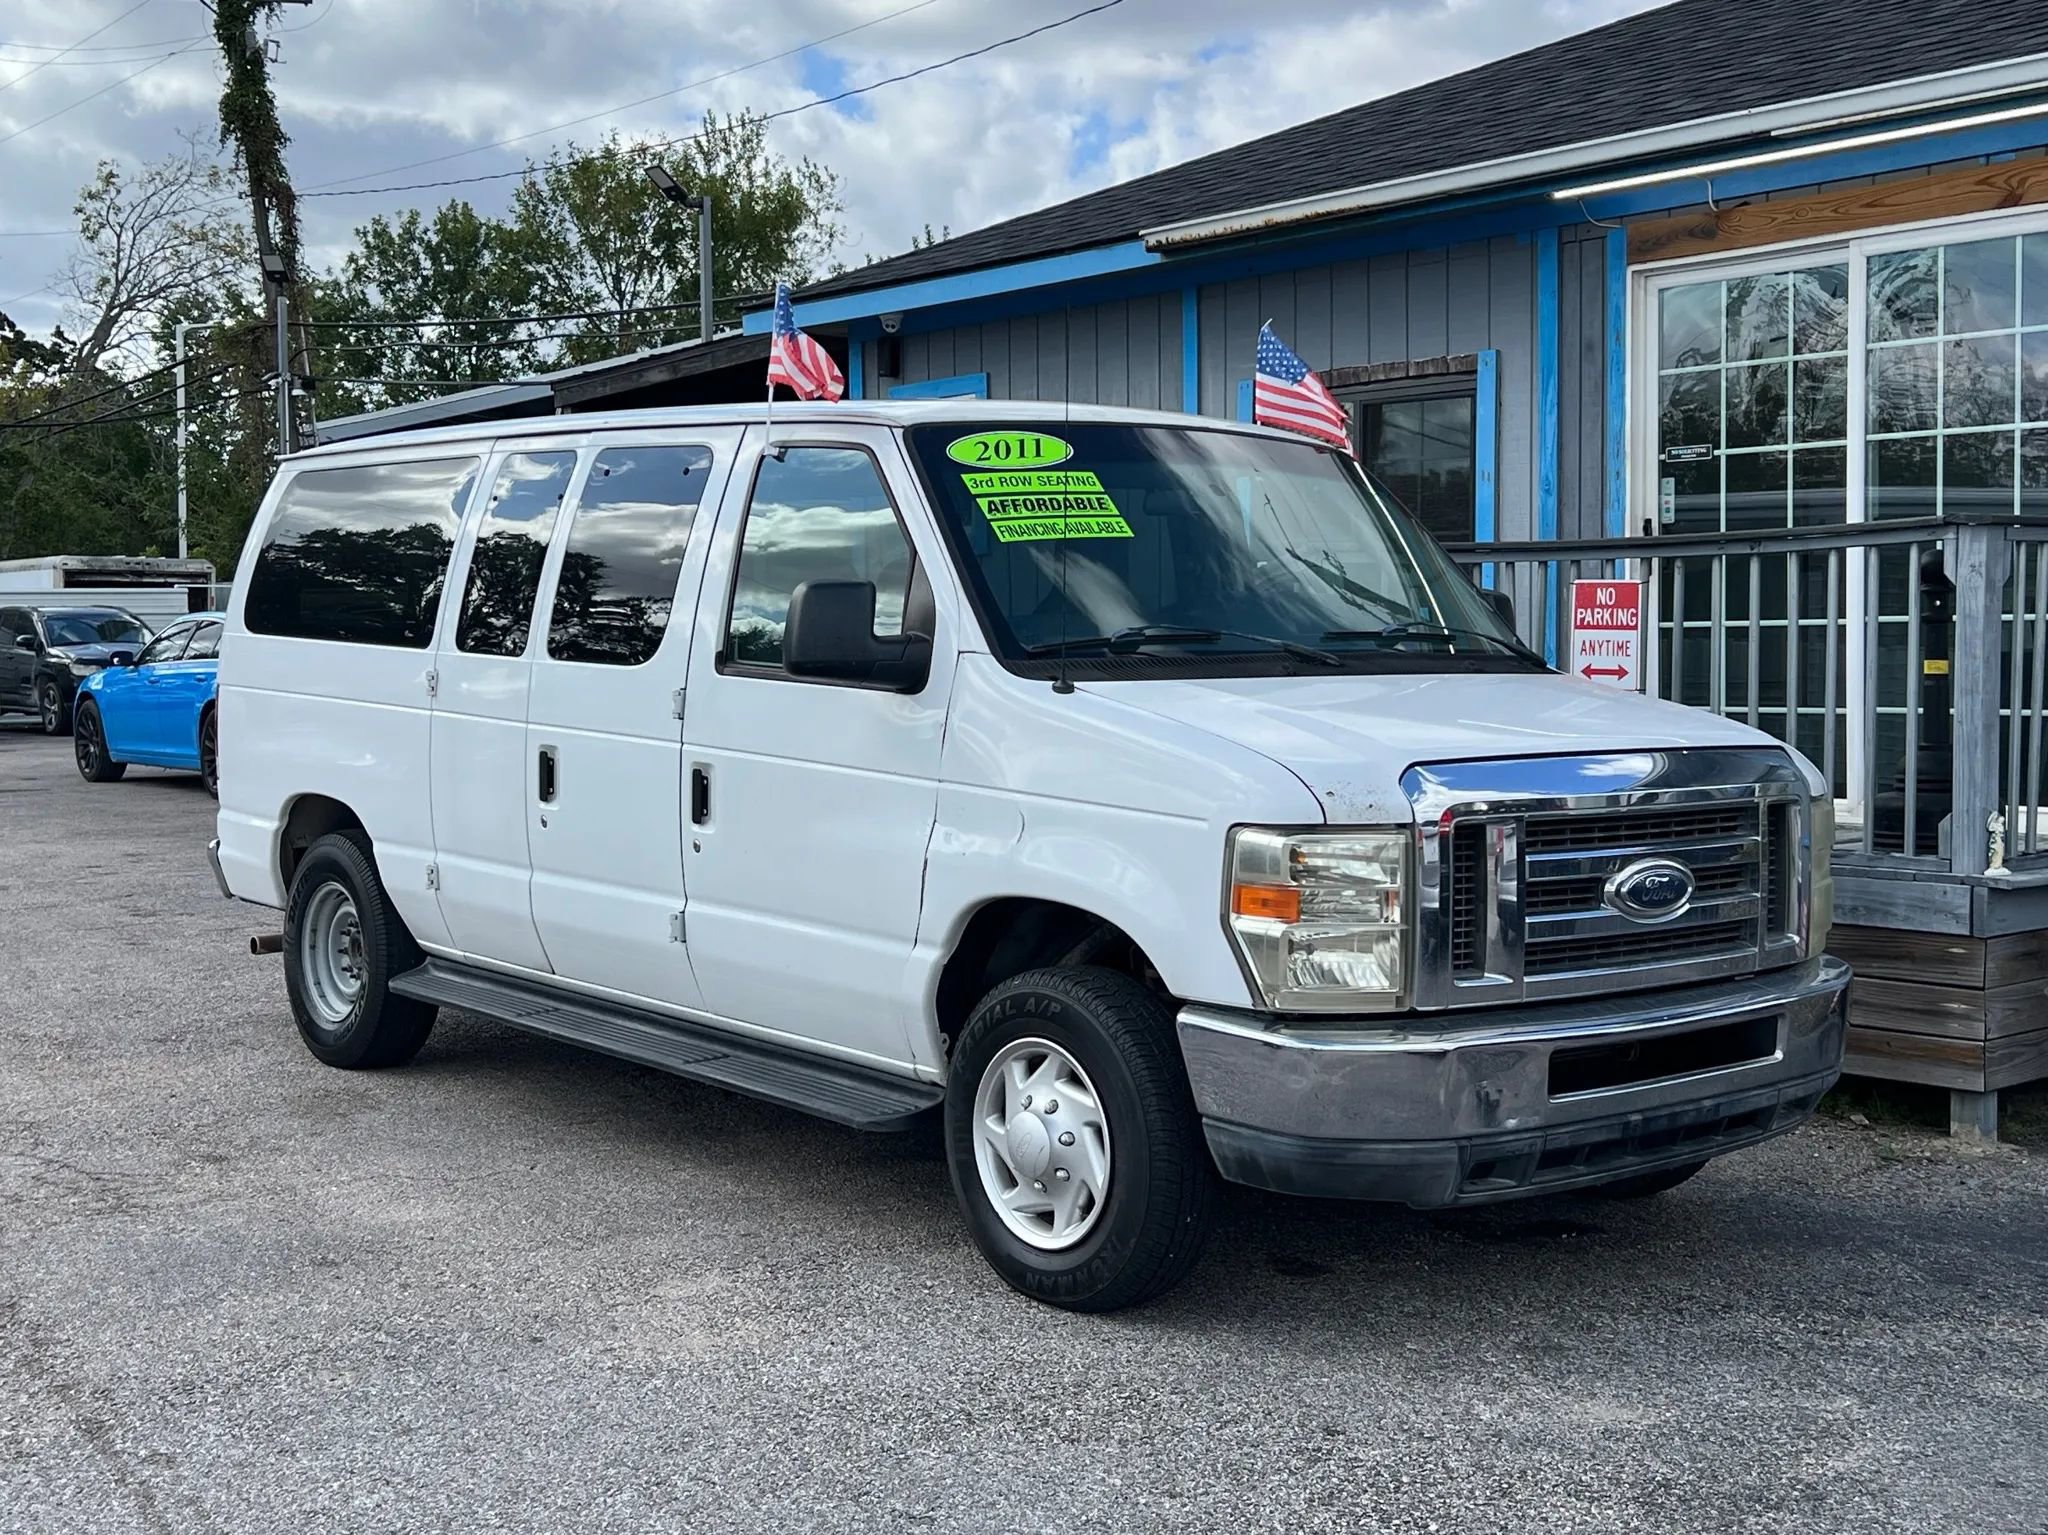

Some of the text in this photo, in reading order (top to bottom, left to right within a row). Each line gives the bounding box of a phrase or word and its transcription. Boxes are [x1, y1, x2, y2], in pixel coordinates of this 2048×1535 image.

[973, 438, 1046, 463] 2011
[969, 475, 1097, 489] 3rd ROW SEATING
[987, 496, 1112, 516] AFFORDABLE
[997, 520, 1128, 539] FINANCING AVAILABLE
[1596, 587, 1616, 606] NO
[1576, 608, 1637, 626] PARKING
[1580, 639, 1632, 657] ANYTIME
[1641, 876, 1675, 902] Ford
[1023, 996, 1063, 1016] A/P
